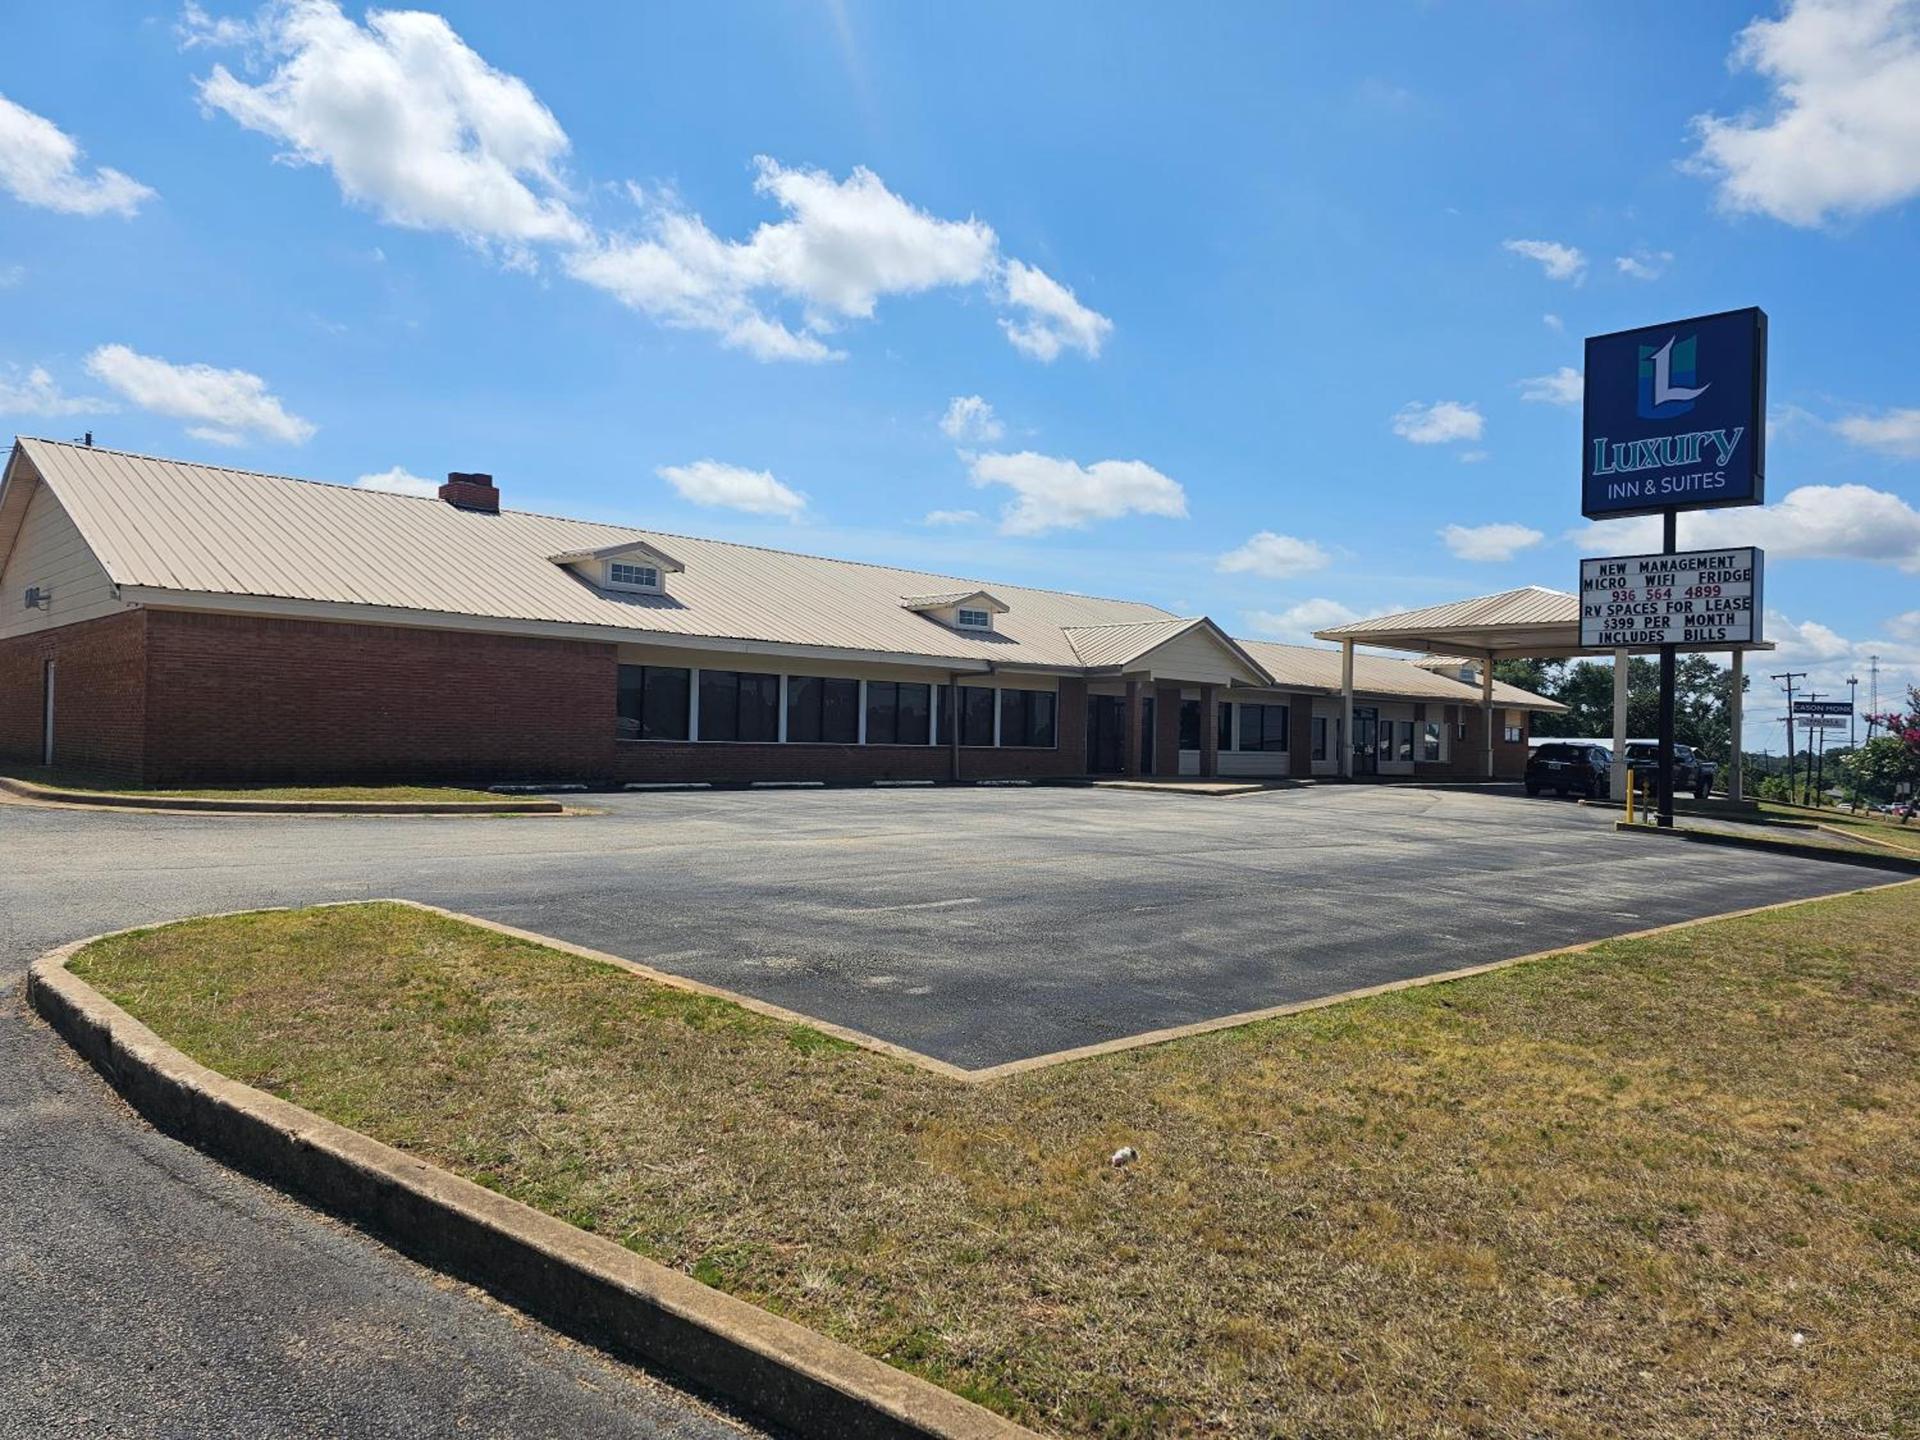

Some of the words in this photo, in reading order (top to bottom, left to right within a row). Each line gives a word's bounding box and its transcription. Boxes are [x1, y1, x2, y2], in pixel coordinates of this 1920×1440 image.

[1593, 427, 1744, 475] Luxury
[1608, 481, 1640, 499] INN
[1644, 479, 1656, 495] &
[1660, 471, 1726, 493] SUITES
[1600, 563, 1627, 576] NEW
[1640, 556, 1735, 573] MANAGEMENT
[1584, 577, 1627, 592] MICRO
[1645, 574, 1675, 587] WIFI
[1699, 569, 1751, 584] FRIDGE
[1612, 590, 1636, 602] 936
[1646, 588, 1672, 601] 564
[1684, 585, 1721, 599] 4899
[1585, 605, 1602, 617] RV
[1608, 602, 1659, 616] SPACES
[1666, 601, 1693, 613] FOR
[1706, 597, 1750, 612] LEASE
[1604, 617, 1635, 630] $399
[1644, 616, 1670, 629] PER
[1684, 613, 1735, 627] MONTH
[1600, 630, 1665, 644] INCLUDES
[1684, 628, 1726, 641] BILLS
[1795, 705, 1824, 713] CASON
